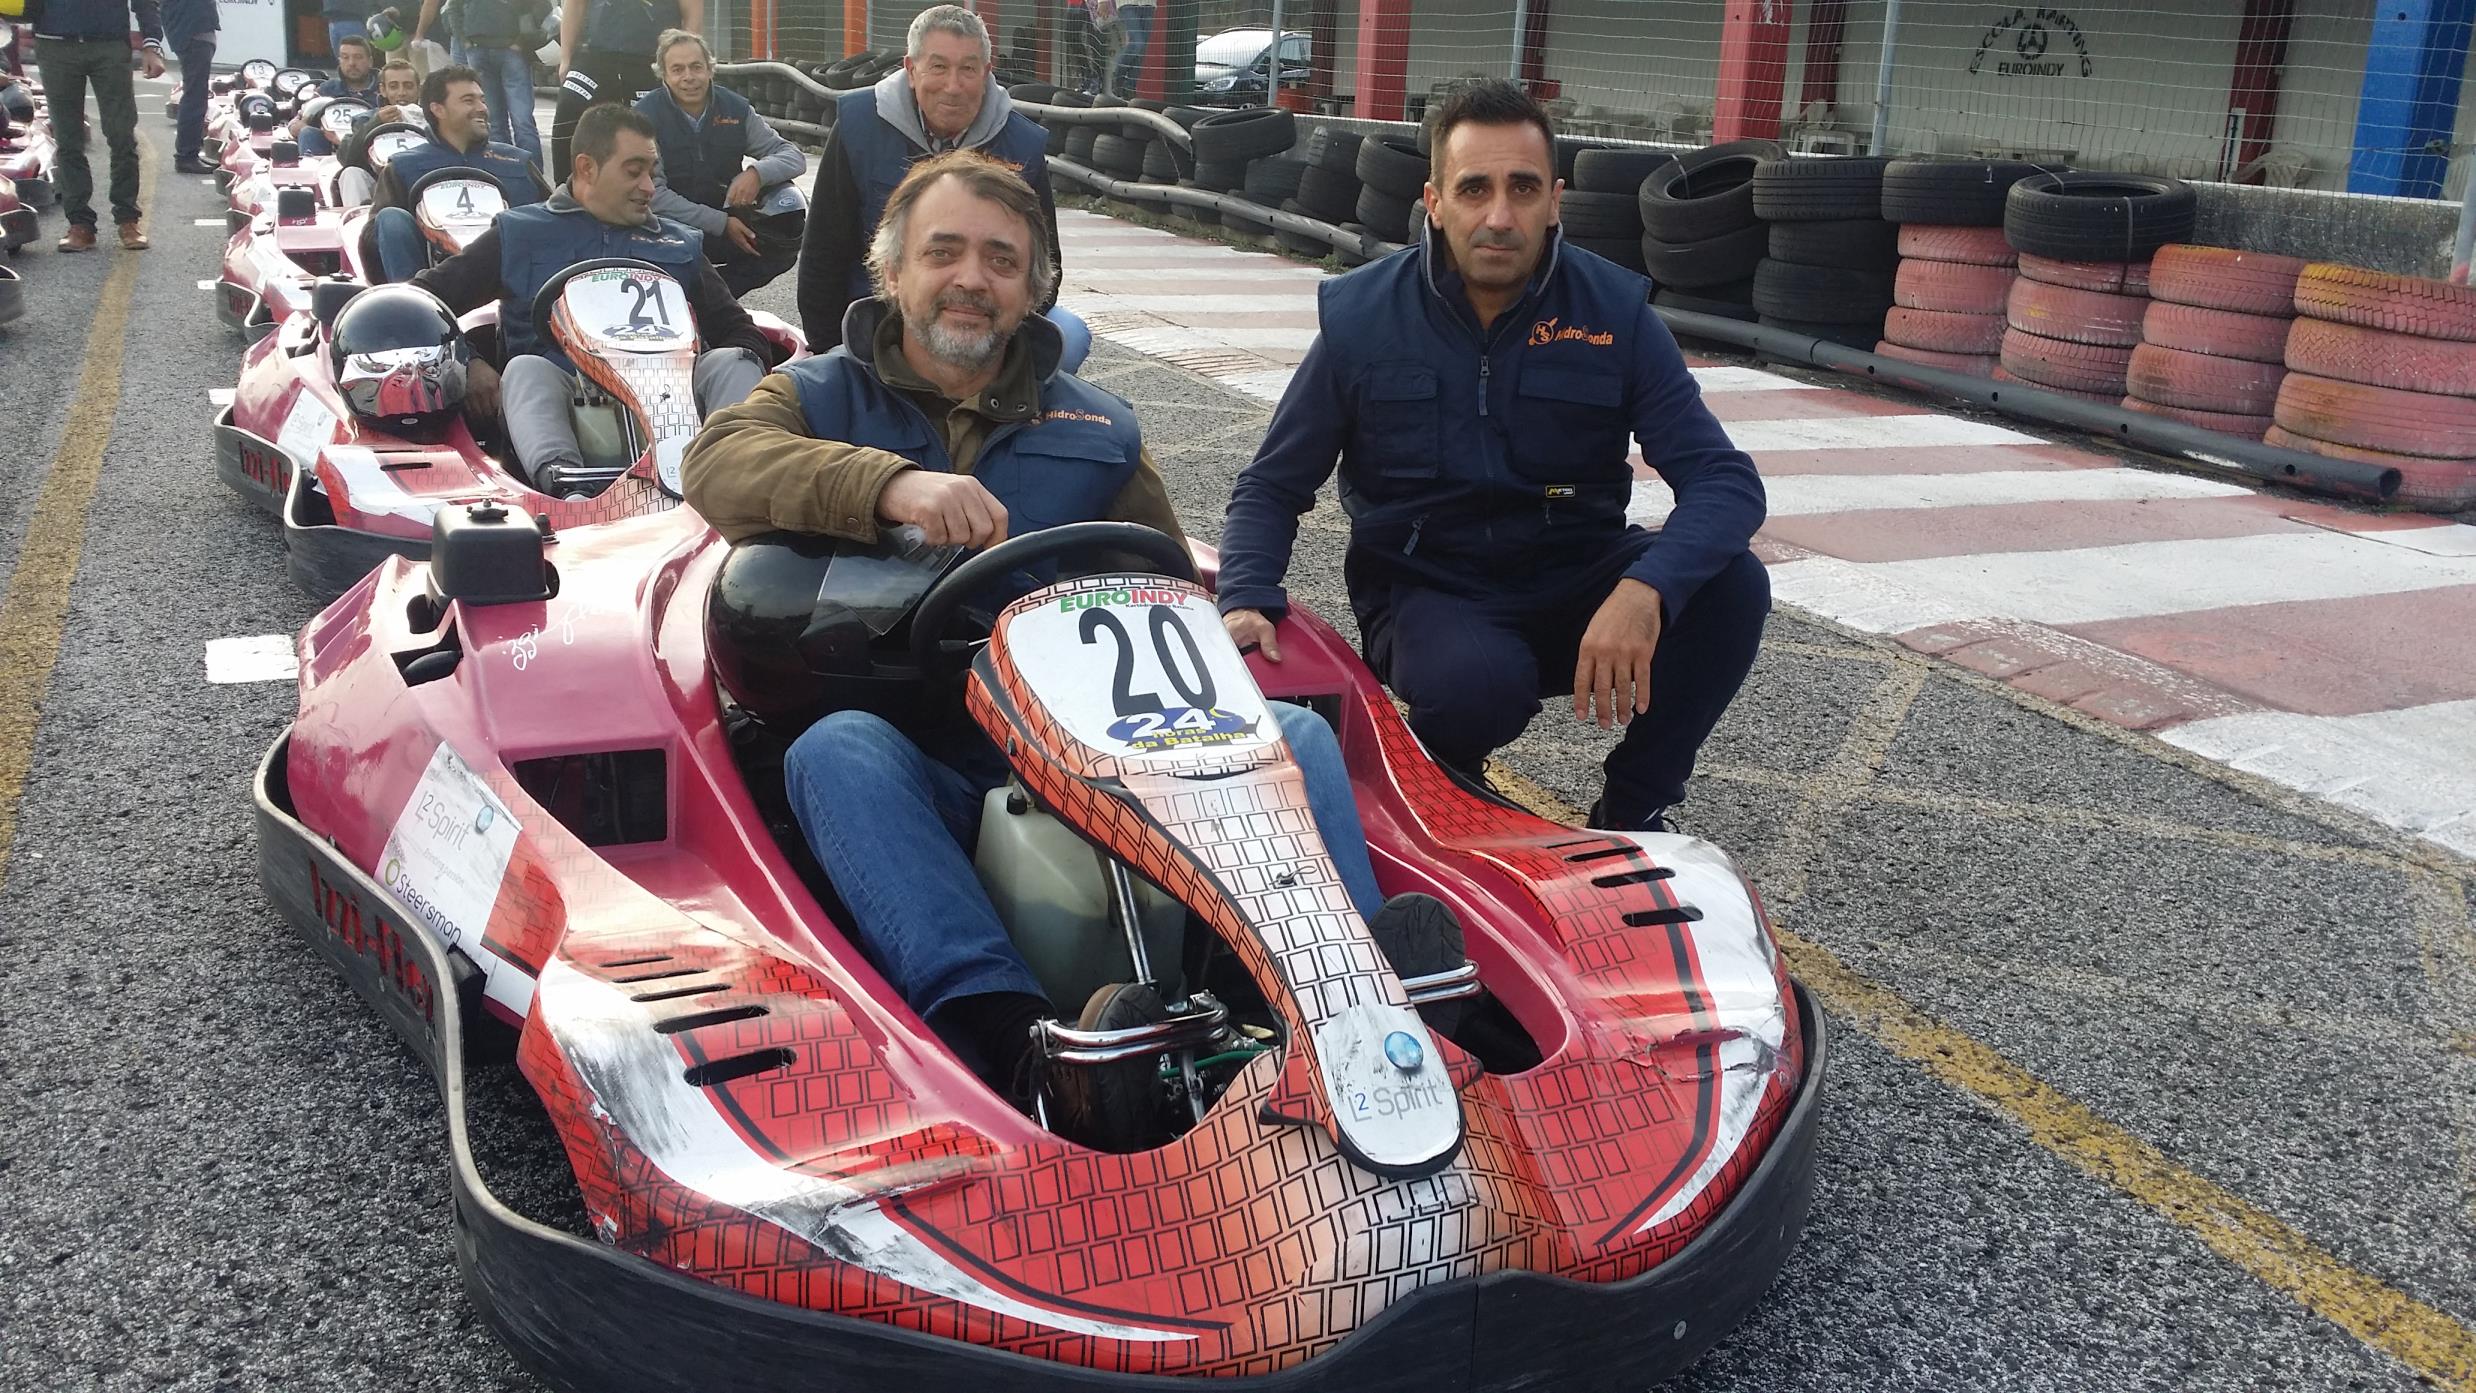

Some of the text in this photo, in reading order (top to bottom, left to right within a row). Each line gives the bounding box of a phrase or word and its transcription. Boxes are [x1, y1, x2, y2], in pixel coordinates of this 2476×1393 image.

[252, 65, 265, 75] 13
[1997, 61, 2065, 77] EUROINDY
[332, 109, 351, 124] 25
[456, 186, 475, 213] 4
[620, 278, 671, 325] 21
[1045, 409, 1112, 426] HidroSonda
[1060, 588, 1189, 614] EUROINDY
[1078, 604, 1217, 718] 20
[1125, 708, 1217, 739] 24
[1152, 728, 1207, 740] horas
[1131, 731, 1247, 750] da Batalha
[427, 801, 470, 851] Spirit
[396, 873, 463, 945] Steersman
[1372, 1079, 1443, 1120] Spirit
